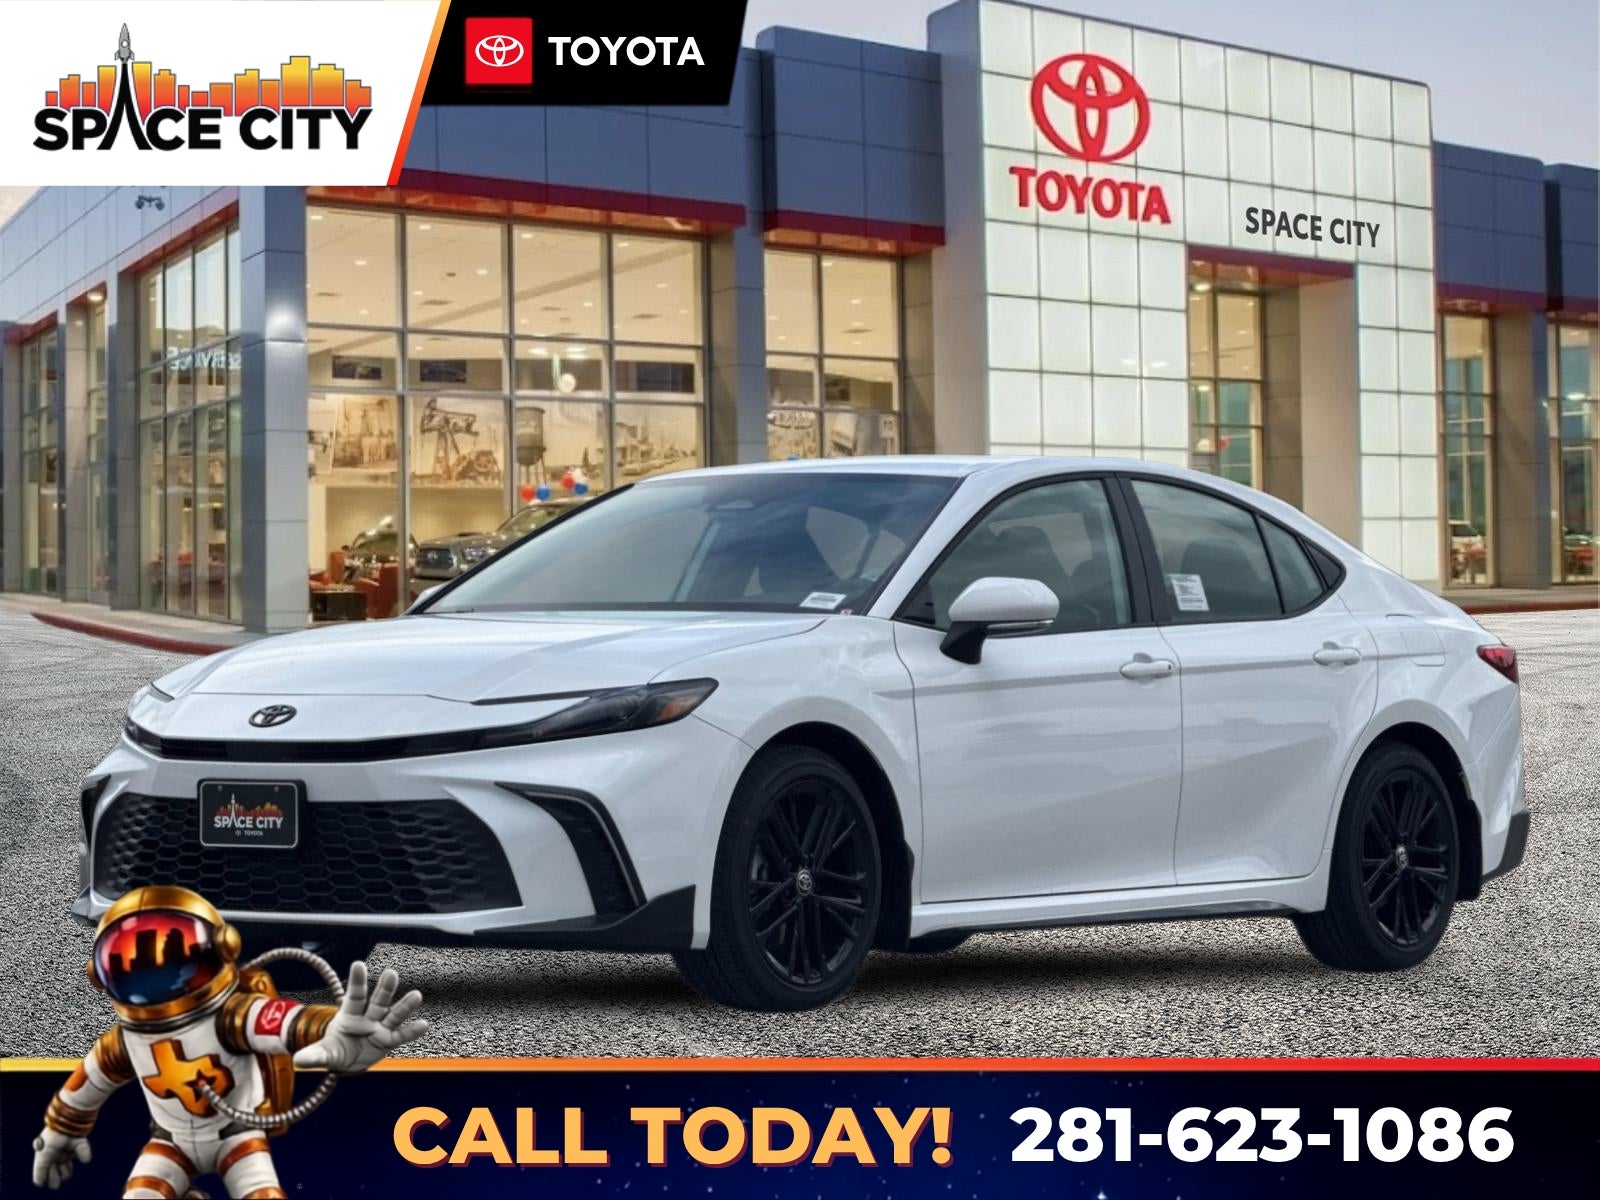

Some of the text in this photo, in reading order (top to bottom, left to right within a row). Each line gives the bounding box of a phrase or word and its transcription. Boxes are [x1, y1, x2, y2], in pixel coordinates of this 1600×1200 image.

[1009, 165, 1172, 225] TOYOTA
[1245, 206, 1381, 248] SPACE CITY
[213, 815, 283, 829] SPACE CITY
